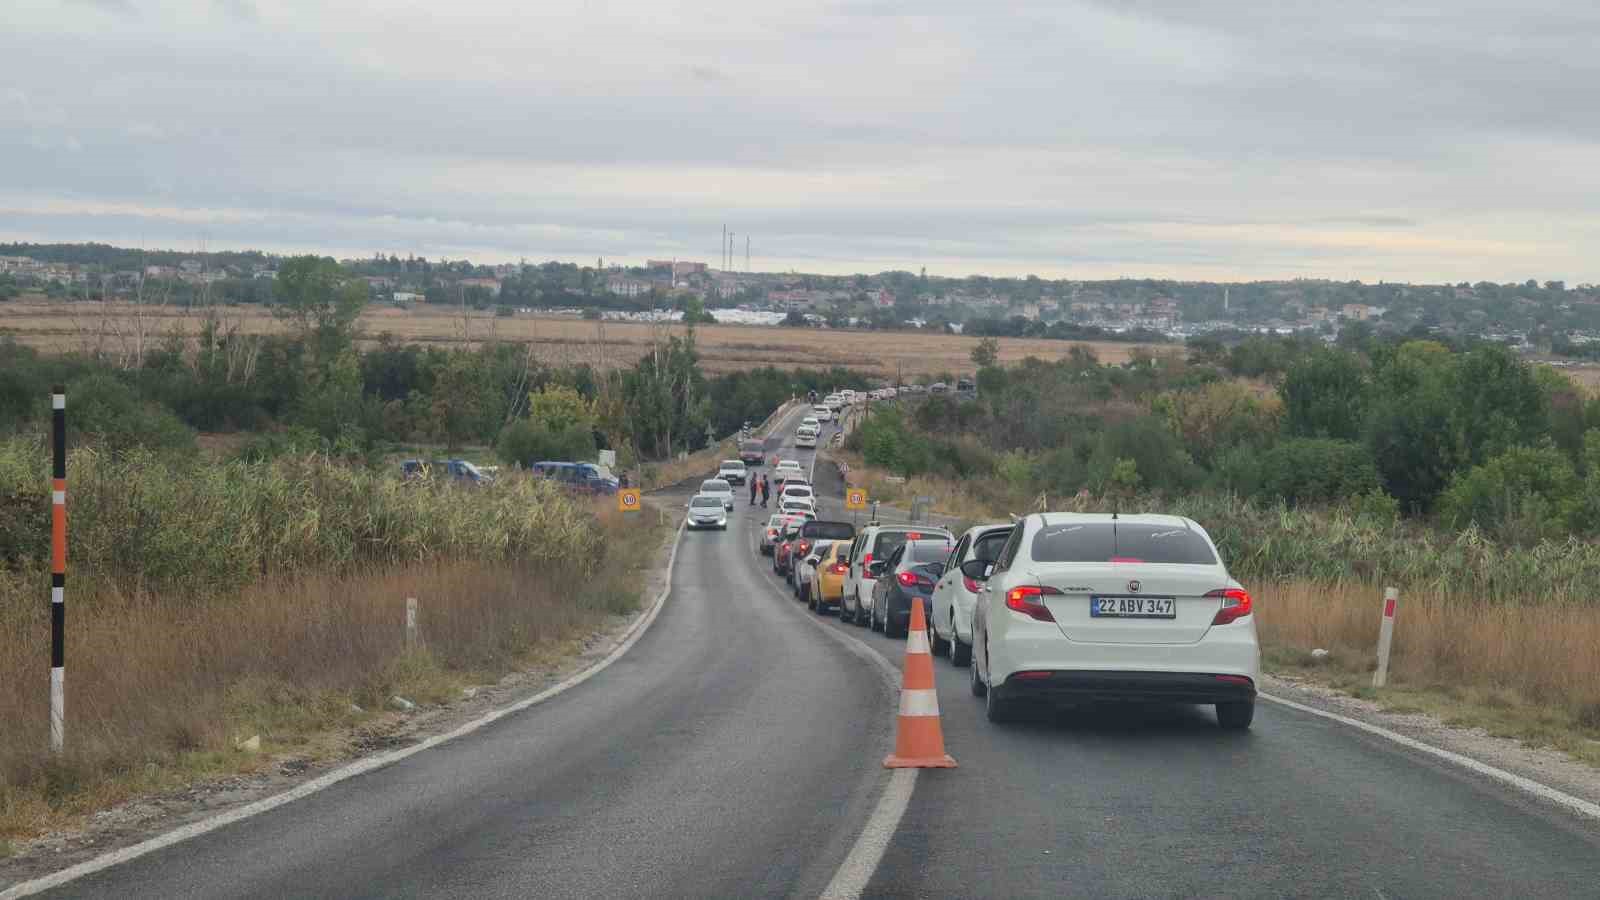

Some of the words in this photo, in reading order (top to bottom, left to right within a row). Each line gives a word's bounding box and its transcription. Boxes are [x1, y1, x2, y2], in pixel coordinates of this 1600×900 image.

[1100, 599, 1116, 612] 22
[1119, 599, 1143, 613] ABV
[1147, 600, 1171, 613] 347
